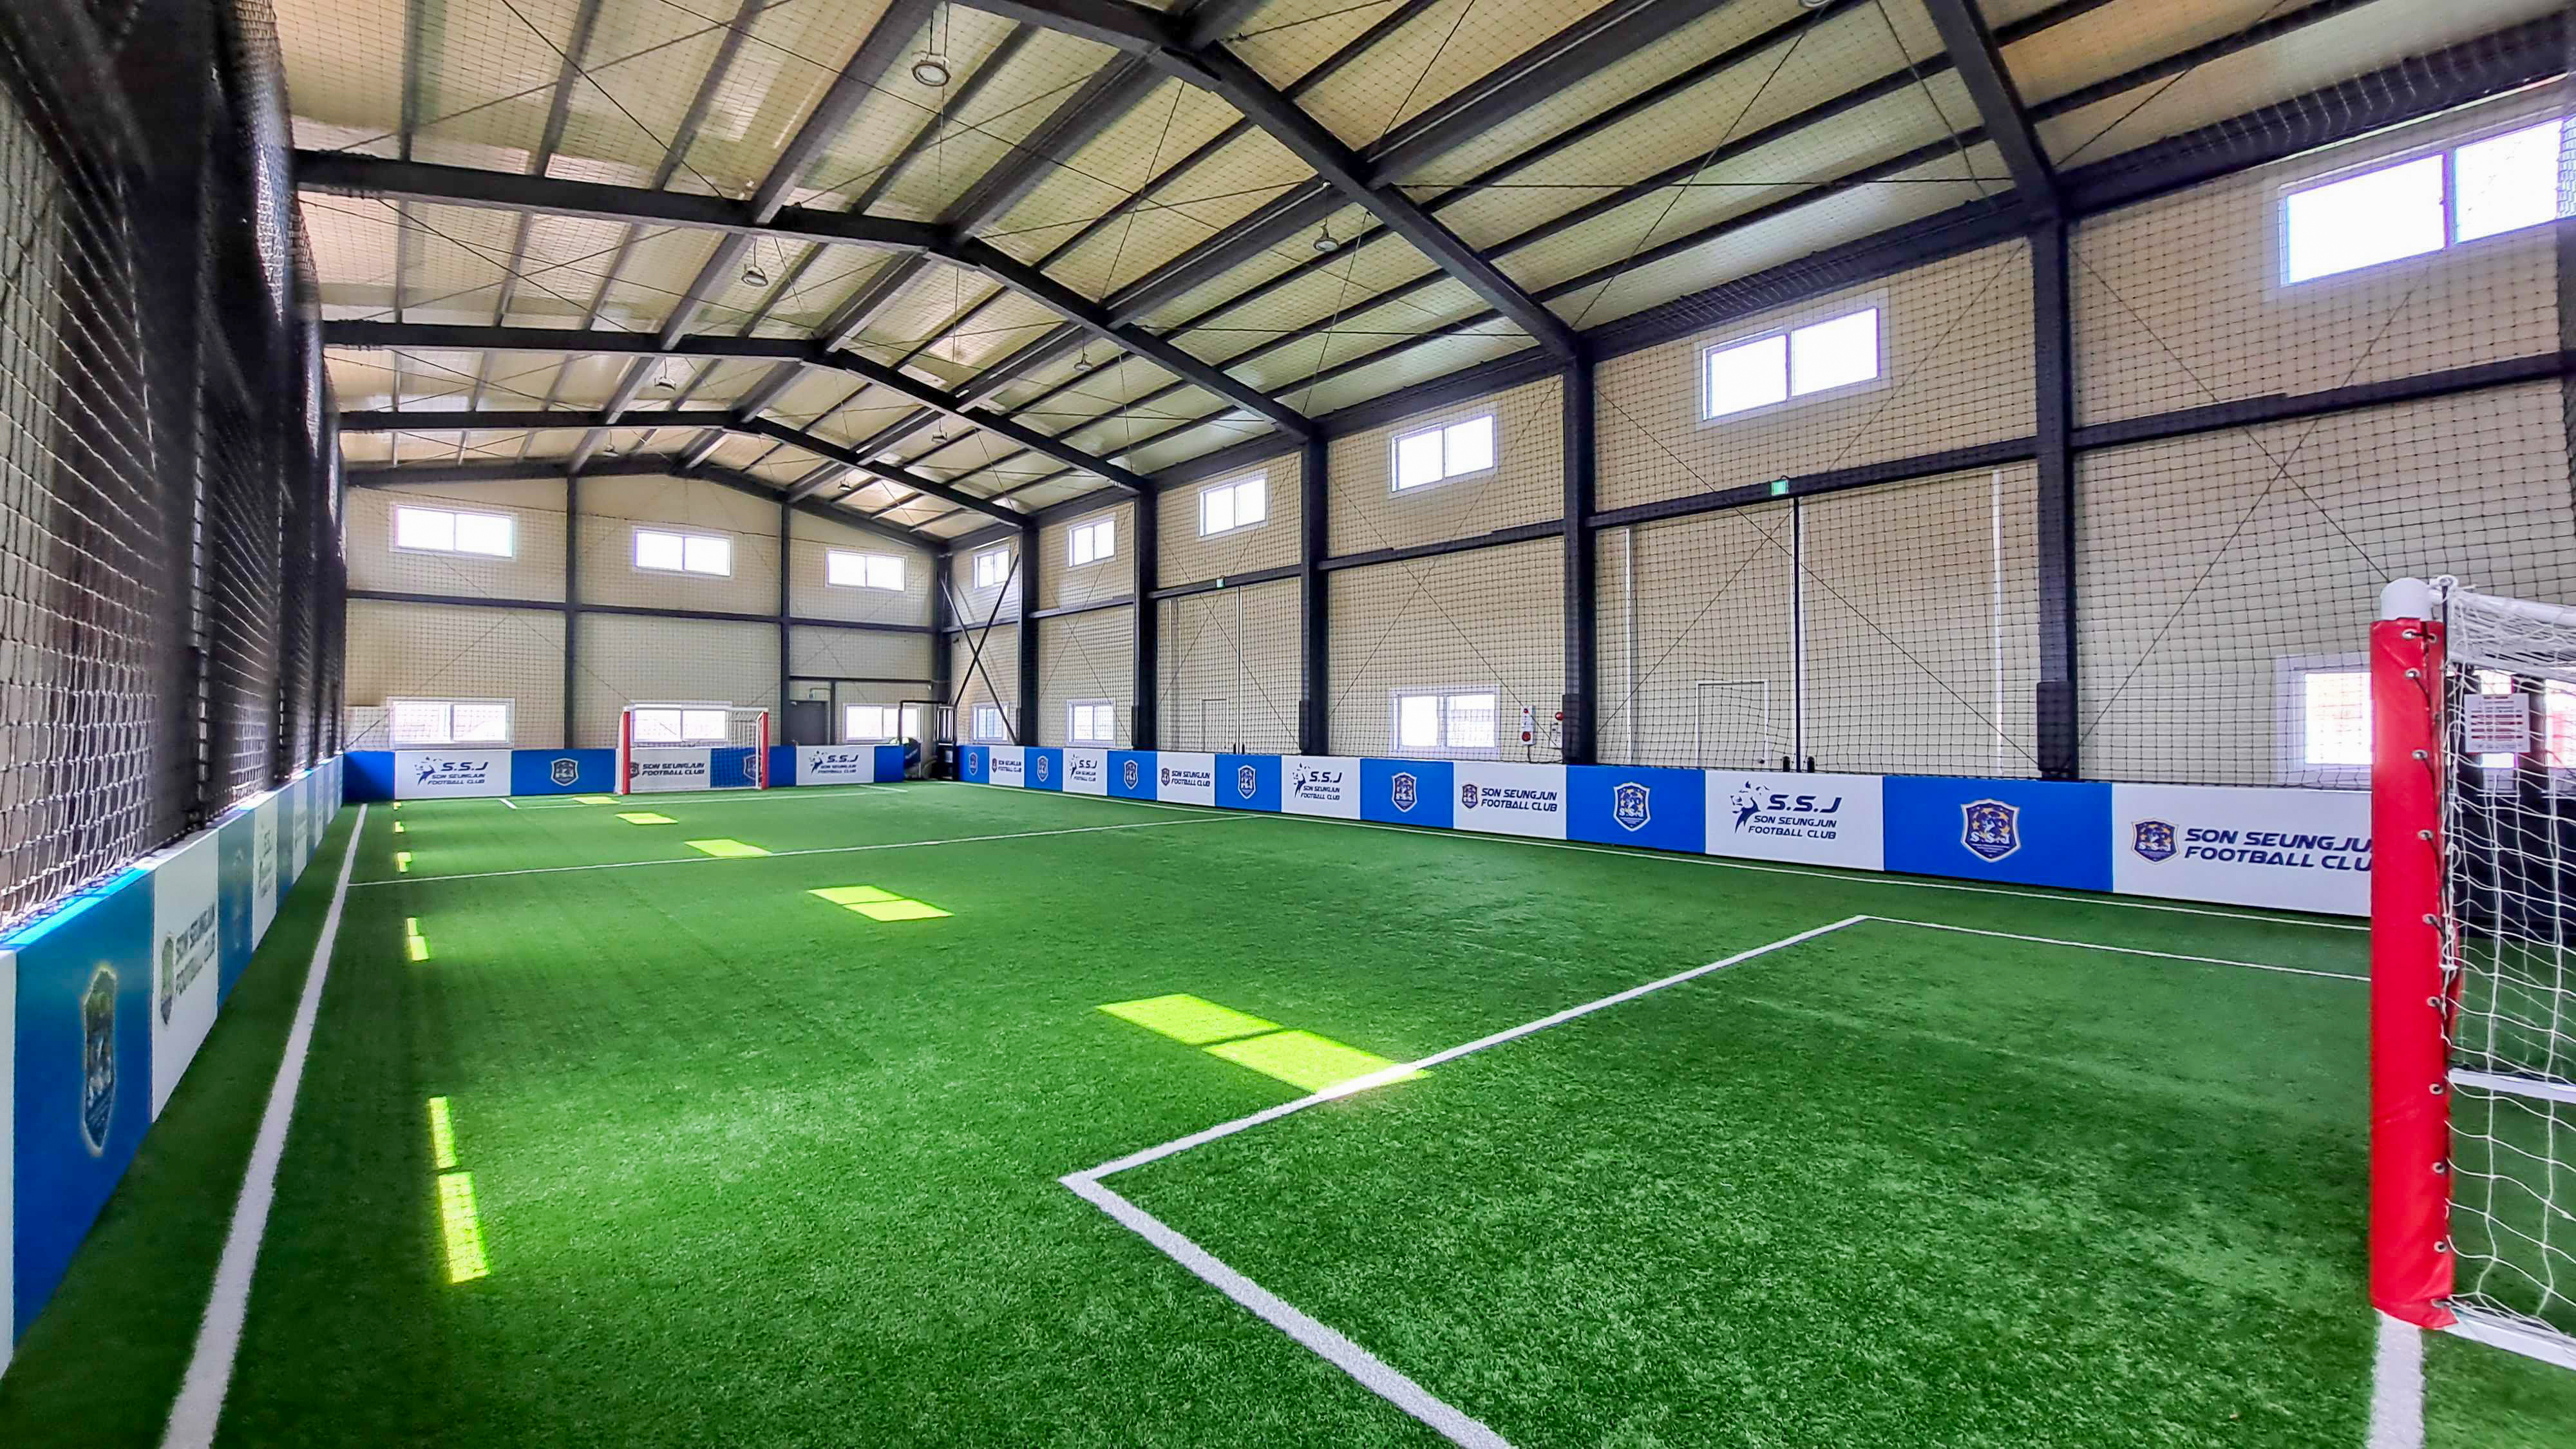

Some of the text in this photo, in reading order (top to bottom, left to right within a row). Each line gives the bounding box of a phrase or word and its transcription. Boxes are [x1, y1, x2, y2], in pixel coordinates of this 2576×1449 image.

[441, 762, 488, 771] S.S.J
[1309, 771, 1342, 783] S.S.J
[1481, 788, 1557, 800] SON SEUNGJUN
[1481, 799, 1558, 812] FOOTBALL CLUB
[1766, 794, 1842, 813] S.S.J
[1754, 815, 1837, 828] SON SEUNGJUN
[1748, 826, 1837, 839] FOOTBALL CLUB
[2184, 828, 2372, 853] SON SEUNGJU
[2184, 846, 2372, 872] FOOTBALL CLU
